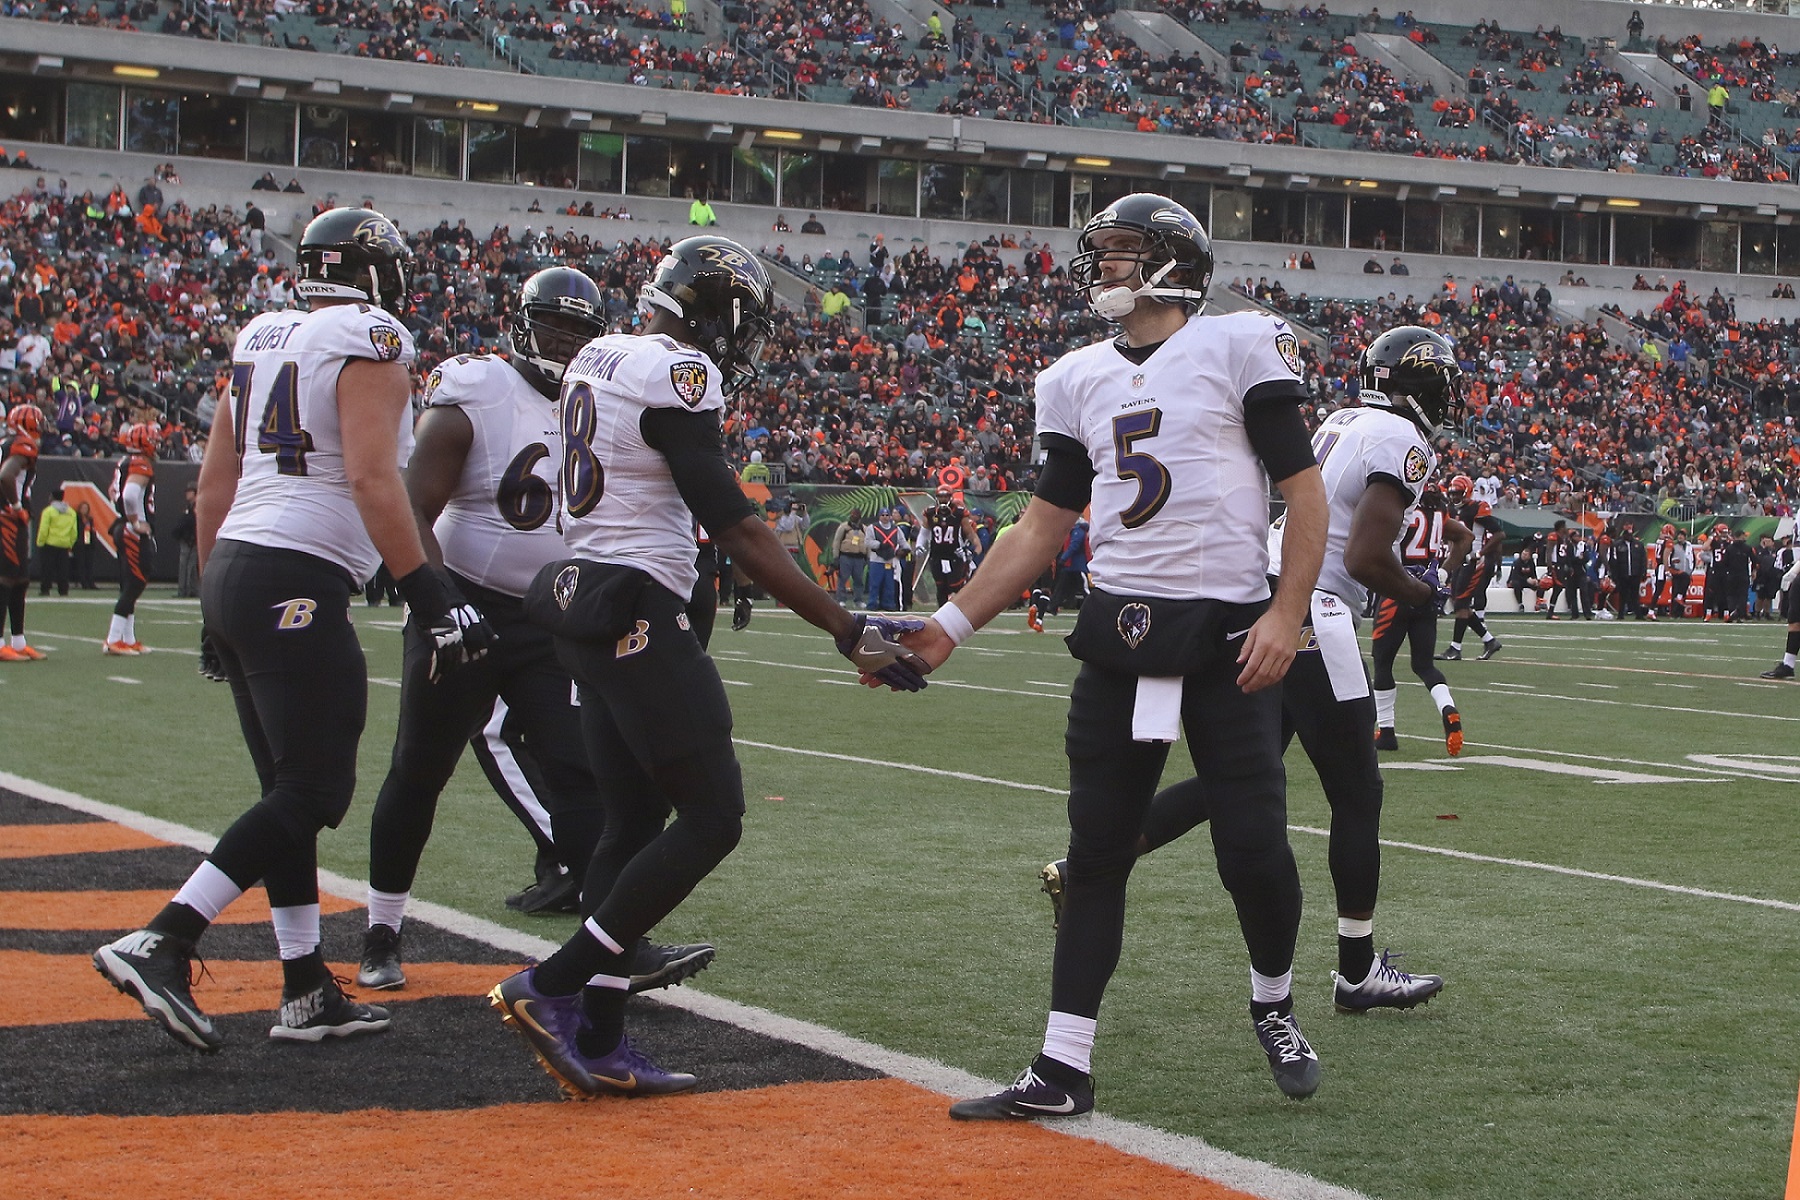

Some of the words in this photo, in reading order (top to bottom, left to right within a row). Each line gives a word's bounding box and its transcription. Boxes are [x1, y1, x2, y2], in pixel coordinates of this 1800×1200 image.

[672, 362, 705, 371] RAVENS
[230, 361, 316, 476] 74
[1121, 397, 1156, 410] RAVENS
[497, 442, 564, 535] 6
[1112, 407, 1172, 529] 5
[932, 525, 954, 544] 94
[1405, 508, 1443, 559] 24
[270, 597, 318, 630] B
[280, 987, 325, 1028] NIKE
